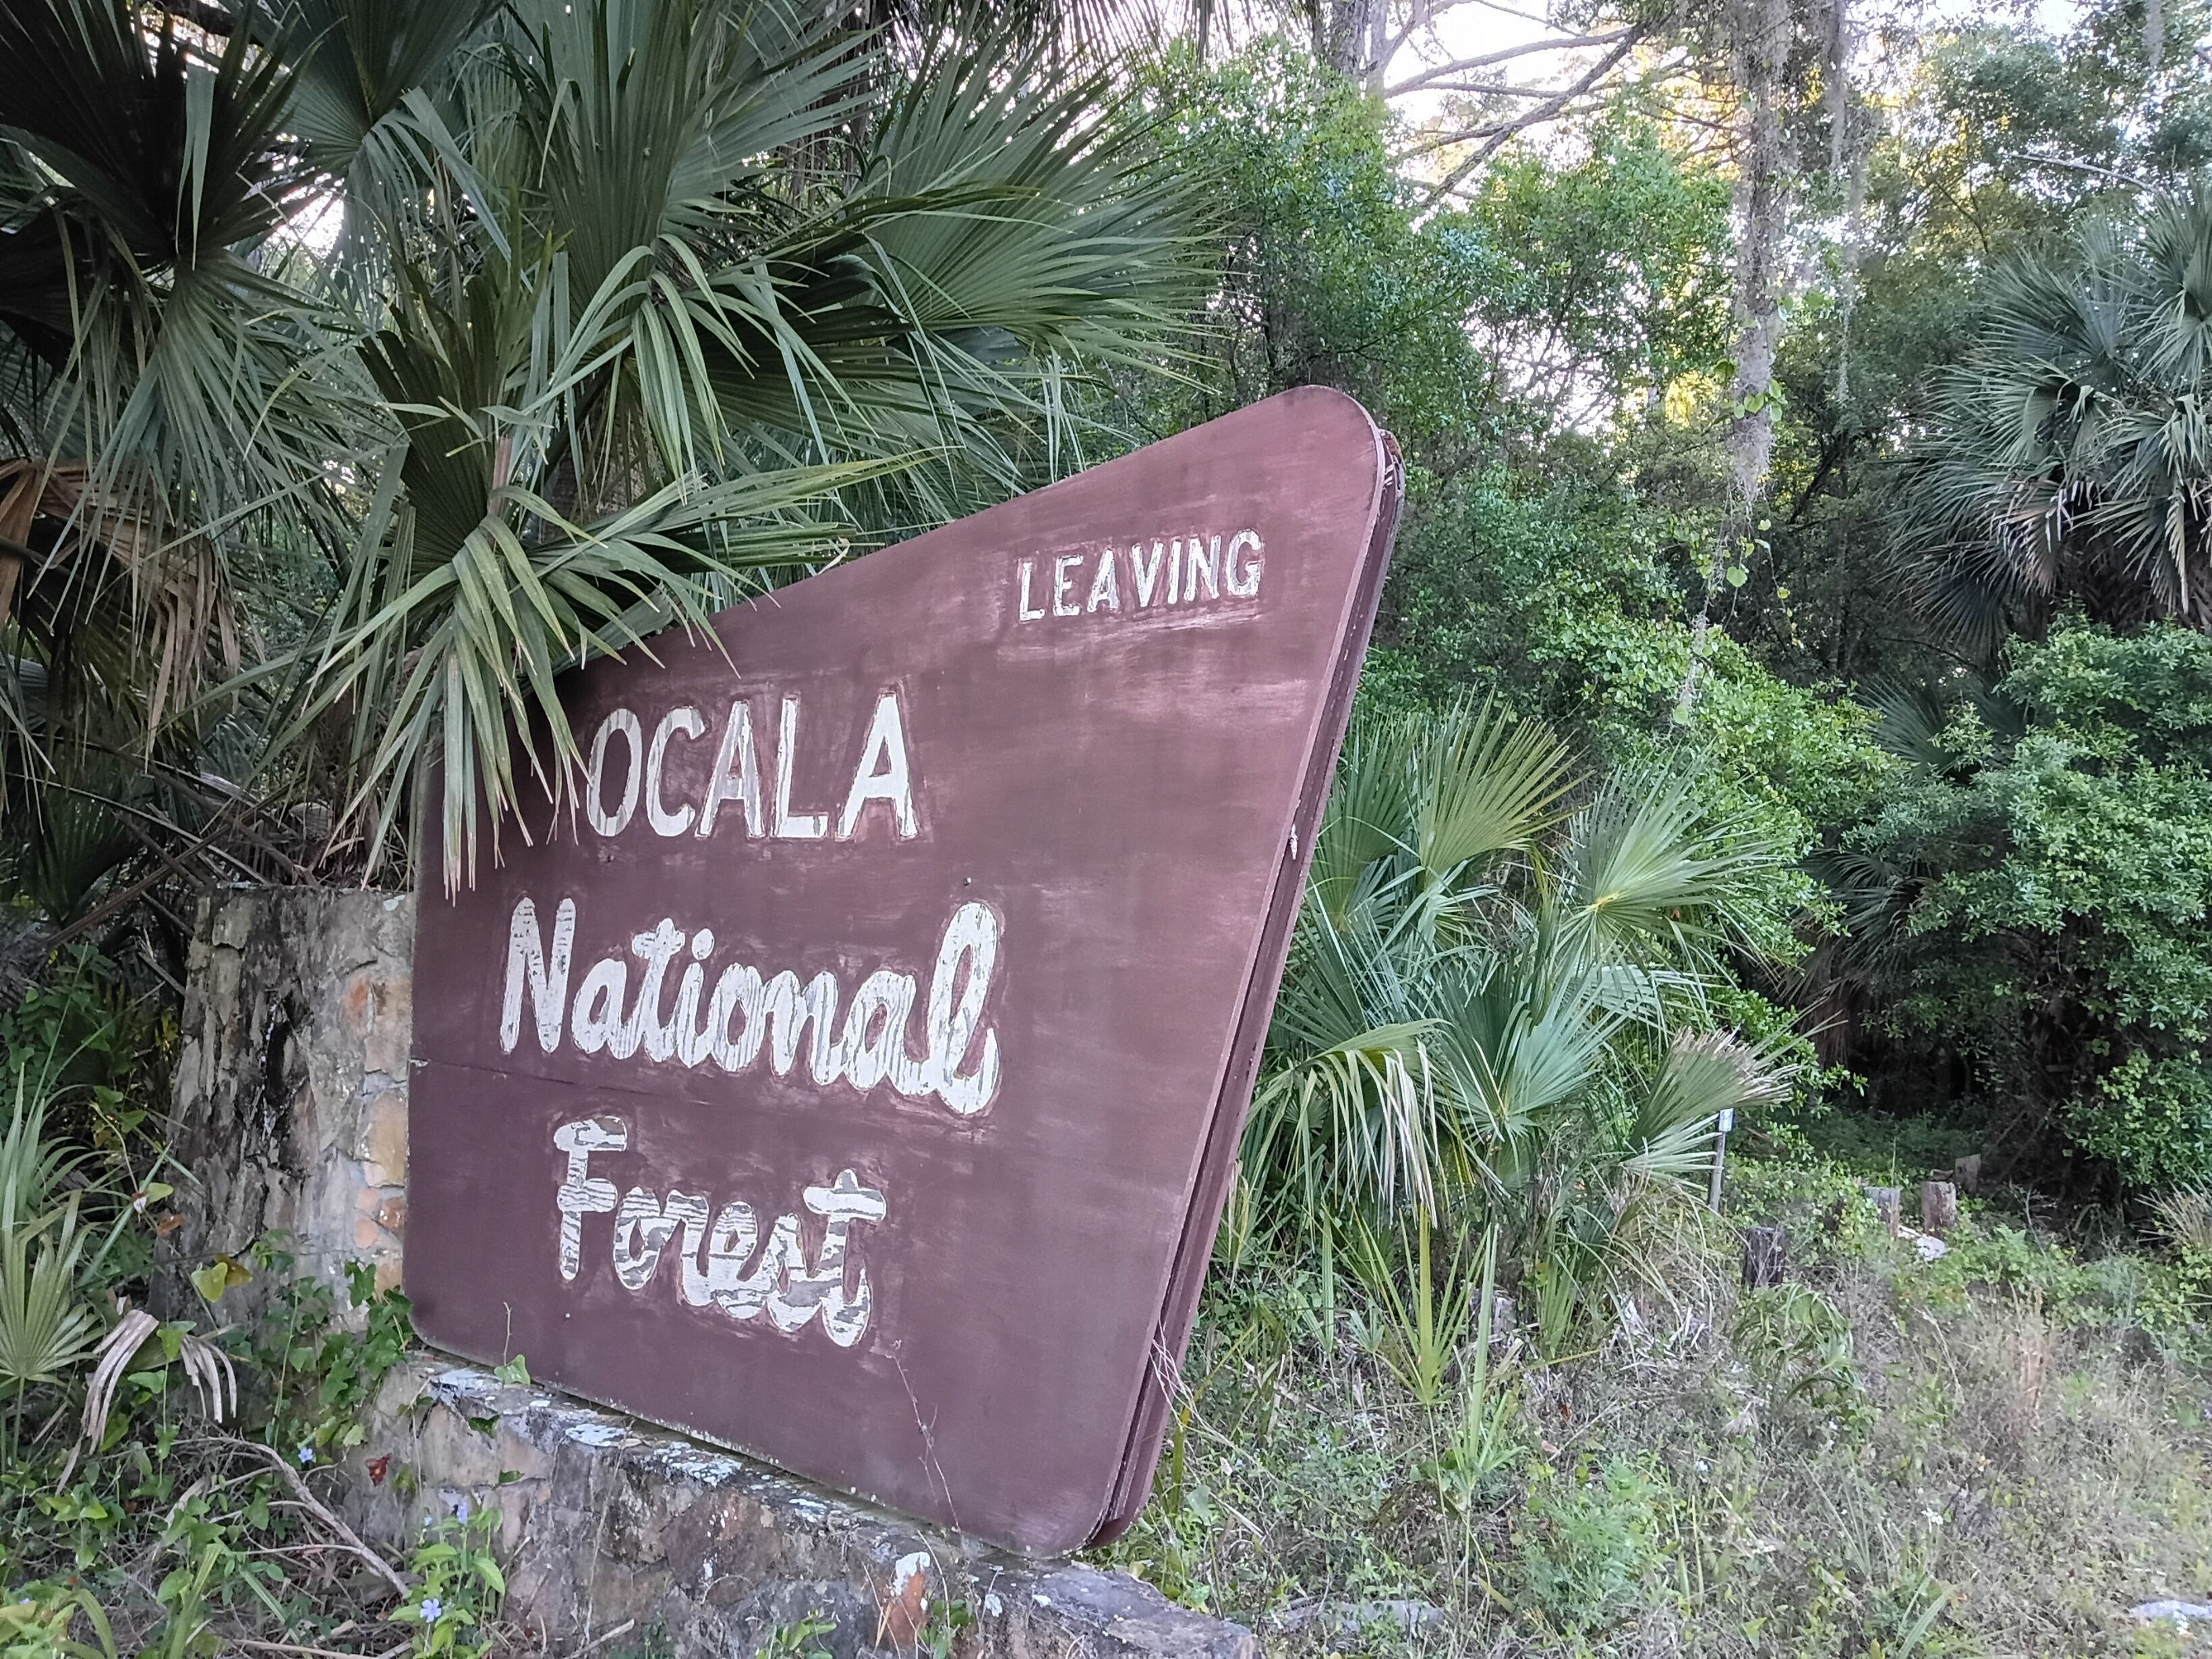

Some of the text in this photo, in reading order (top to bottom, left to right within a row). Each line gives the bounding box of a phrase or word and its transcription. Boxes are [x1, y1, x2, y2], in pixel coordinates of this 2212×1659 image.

[1018, 528, 1262, 620] LEAVING
[585, 693, 918, 838] OCALA
[500, 897, 1000, 1114] National
[553, 1116, 887, 1347] Forest
